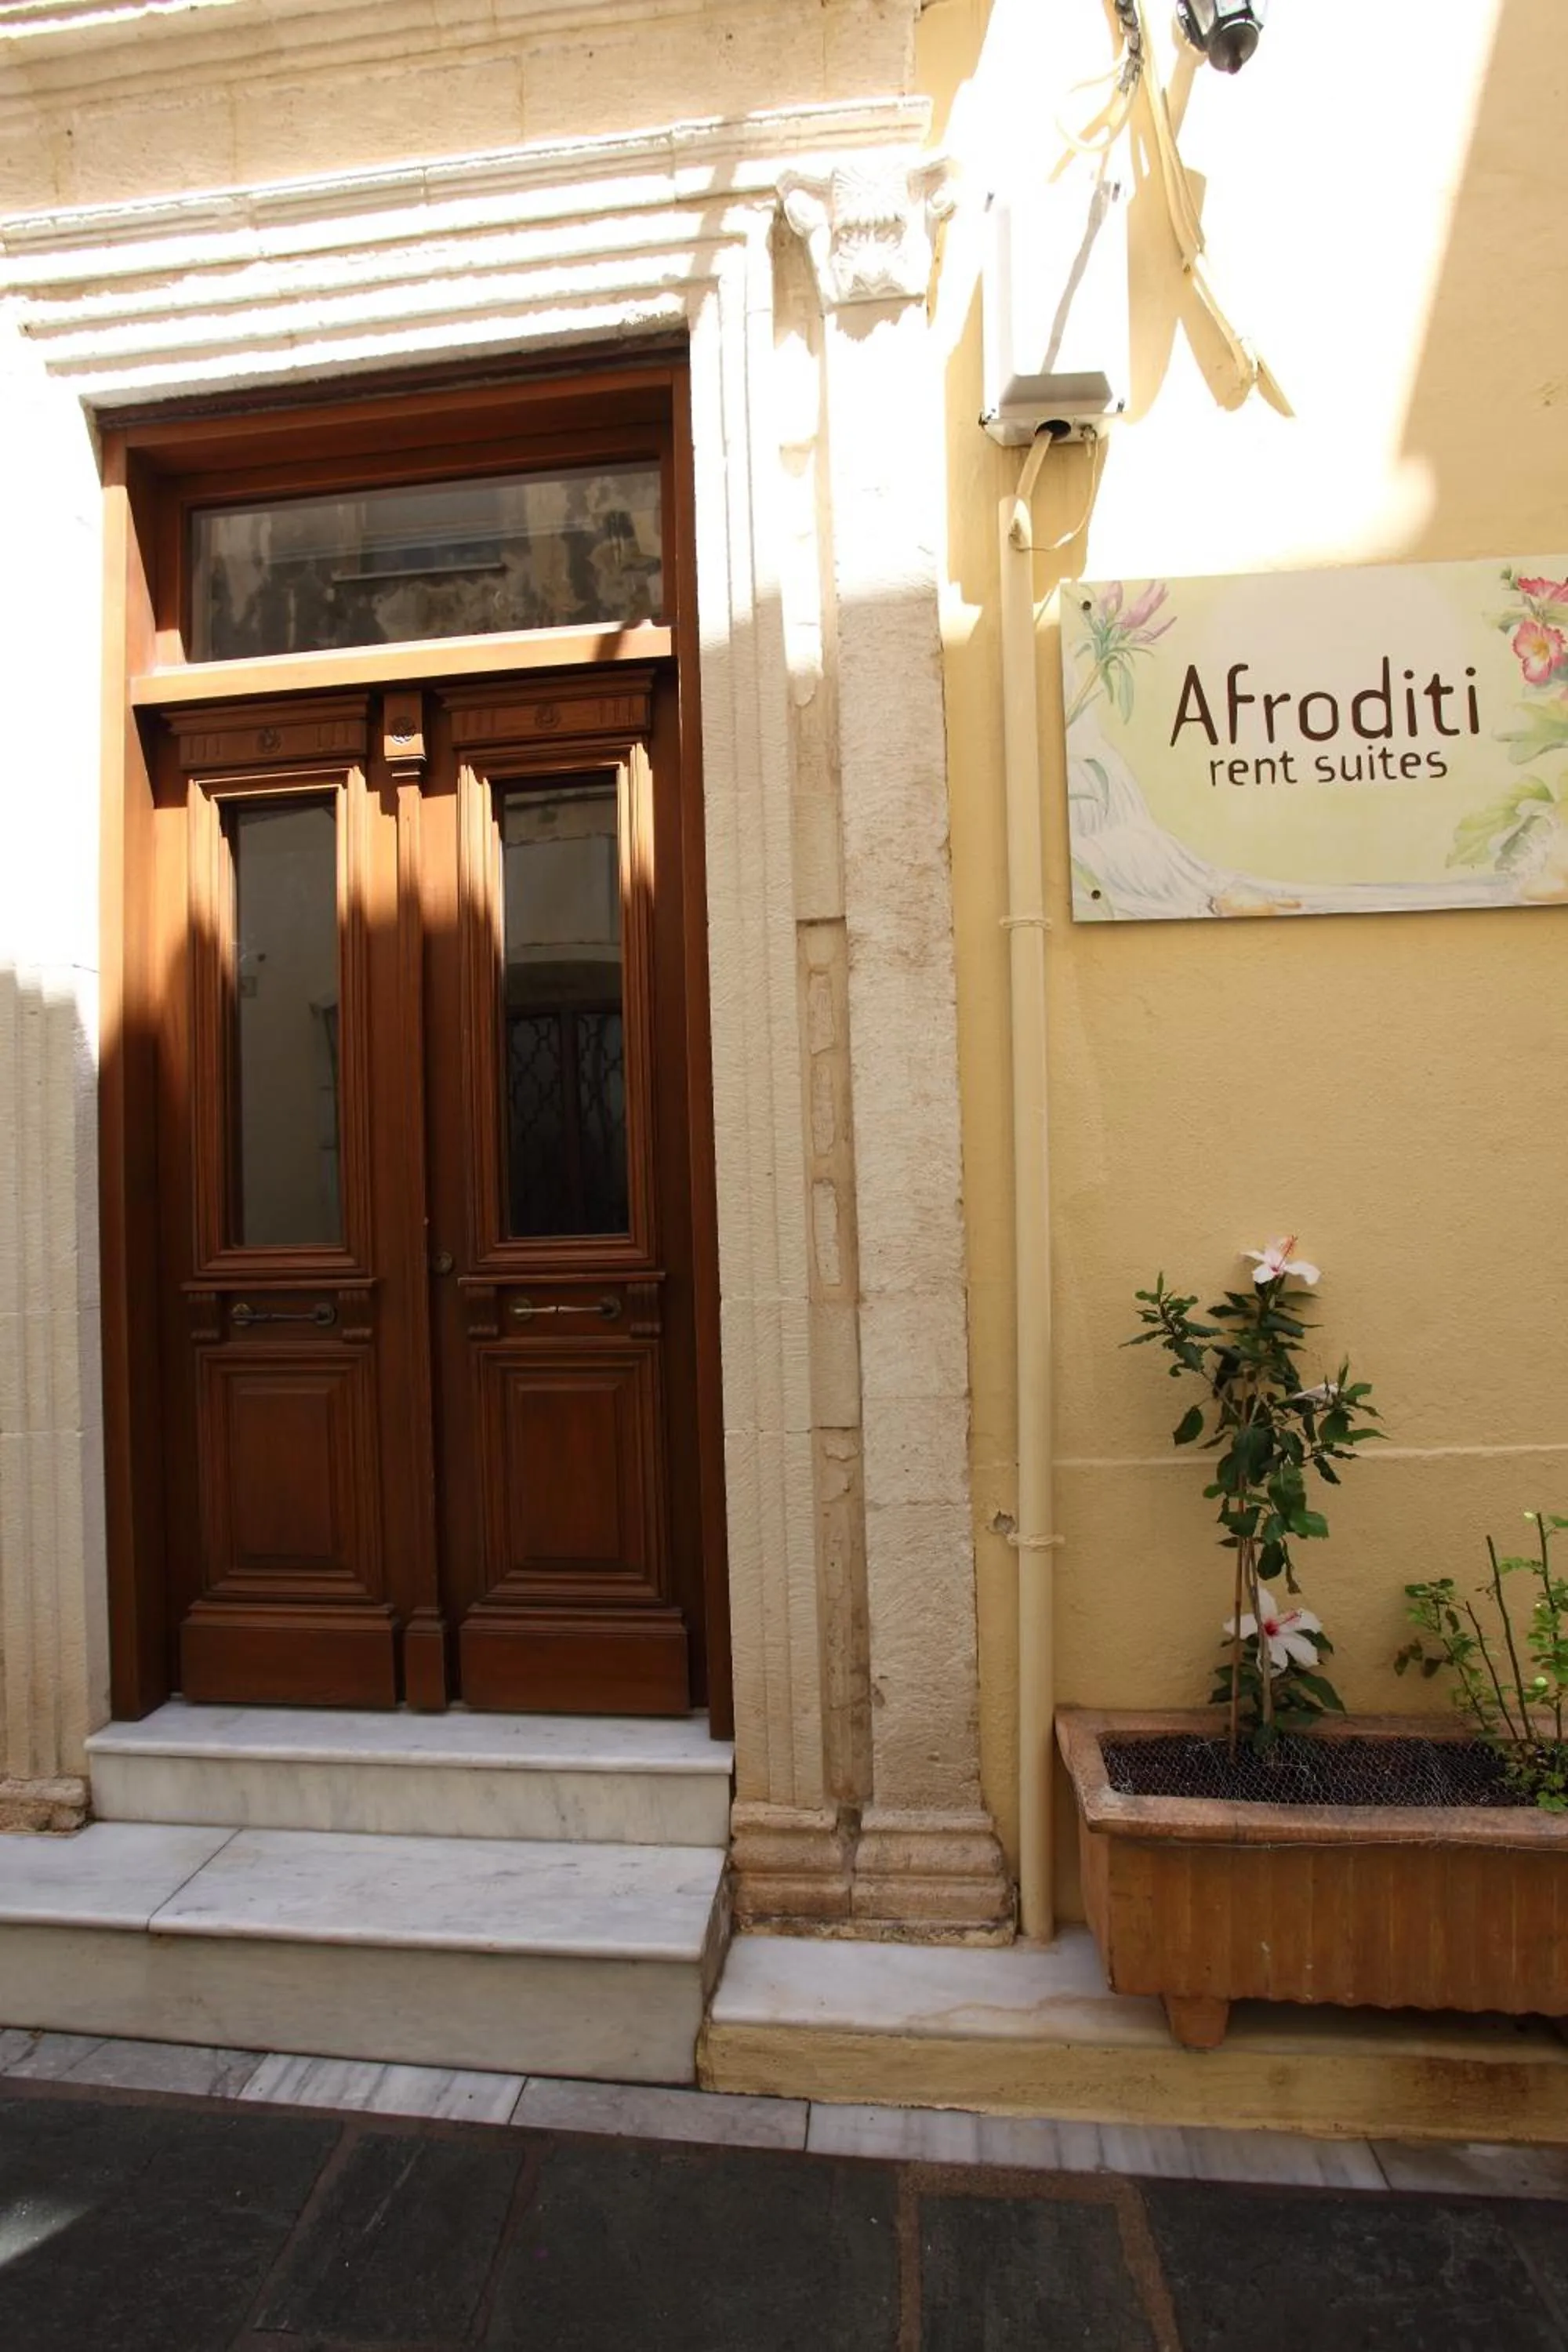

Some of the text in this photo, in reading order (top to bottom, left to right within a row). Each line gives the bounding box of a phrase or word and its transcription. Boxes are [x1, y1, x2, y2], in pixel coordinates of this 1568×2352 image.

[1170, 655, 1480, 747] Afroditi
[1209, 745, 1448, 786] rent suites
